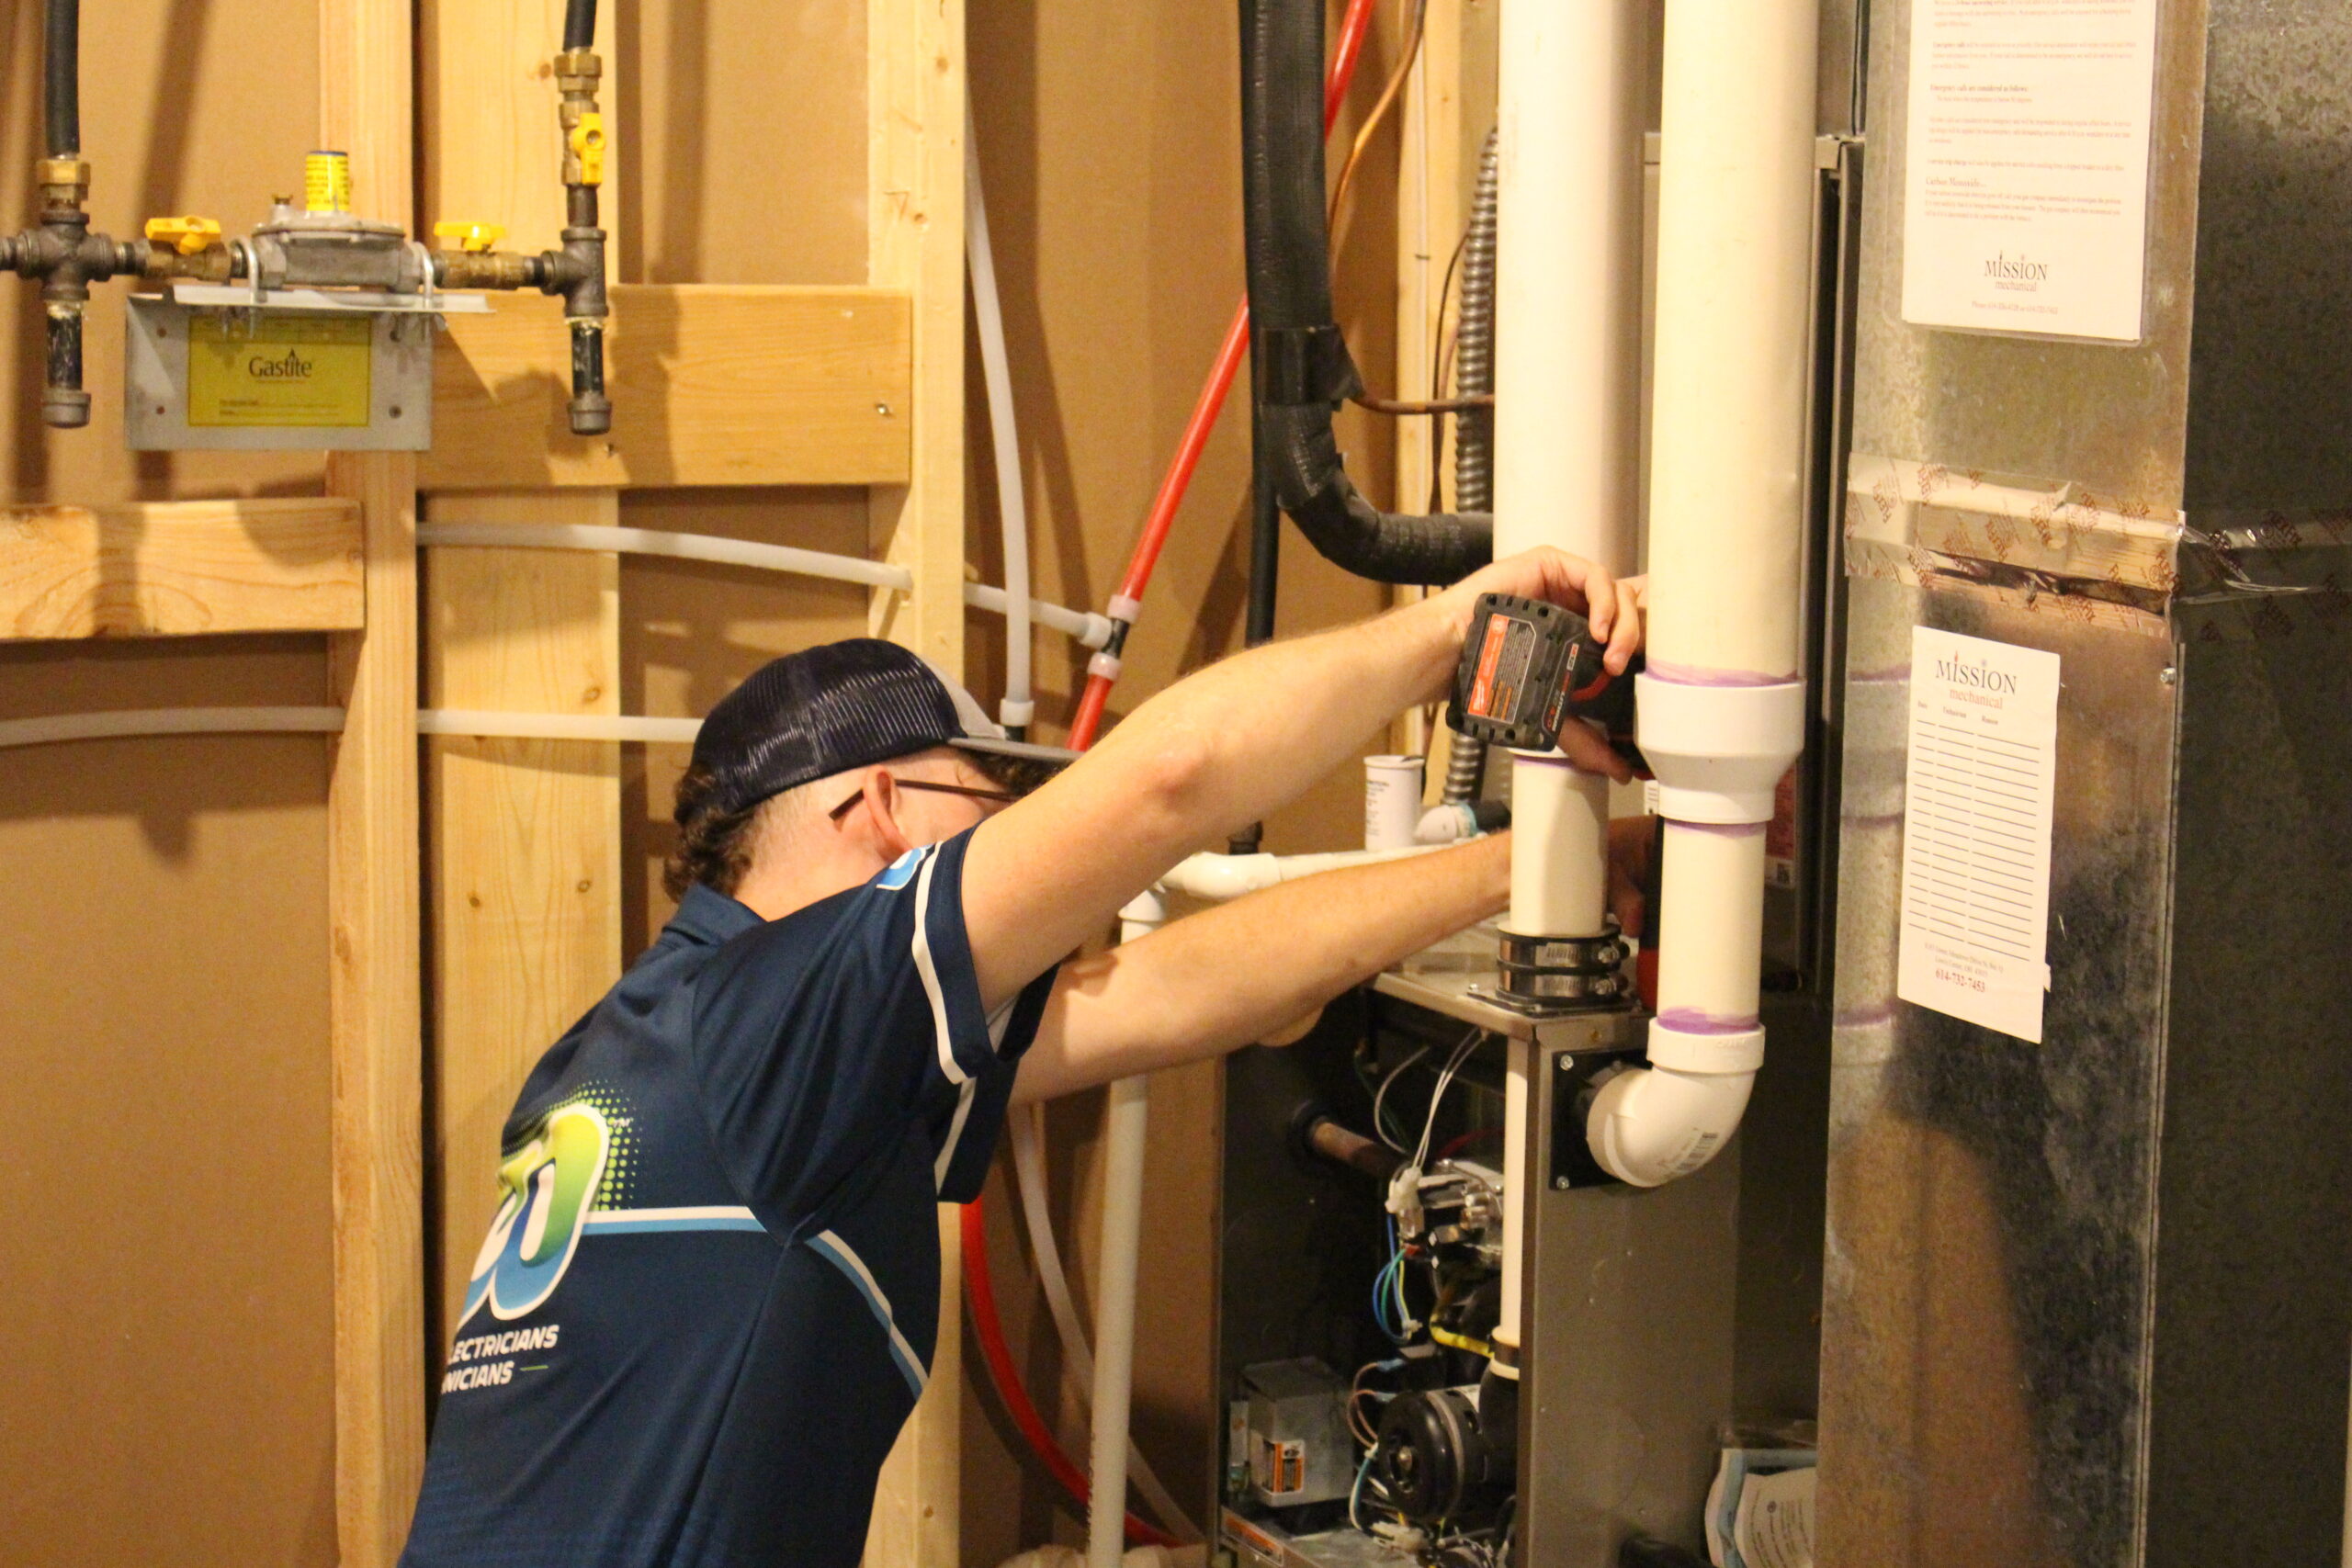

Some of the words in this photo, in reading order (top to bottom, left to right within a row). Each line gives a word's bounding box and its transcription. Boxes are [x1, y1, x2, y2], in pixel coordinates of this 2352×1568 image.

[249, 348, 312, 378] Gastite
[1950, 689, 2003, 710] mechanical
[441, 1360, 515, 1395] NICIANS
